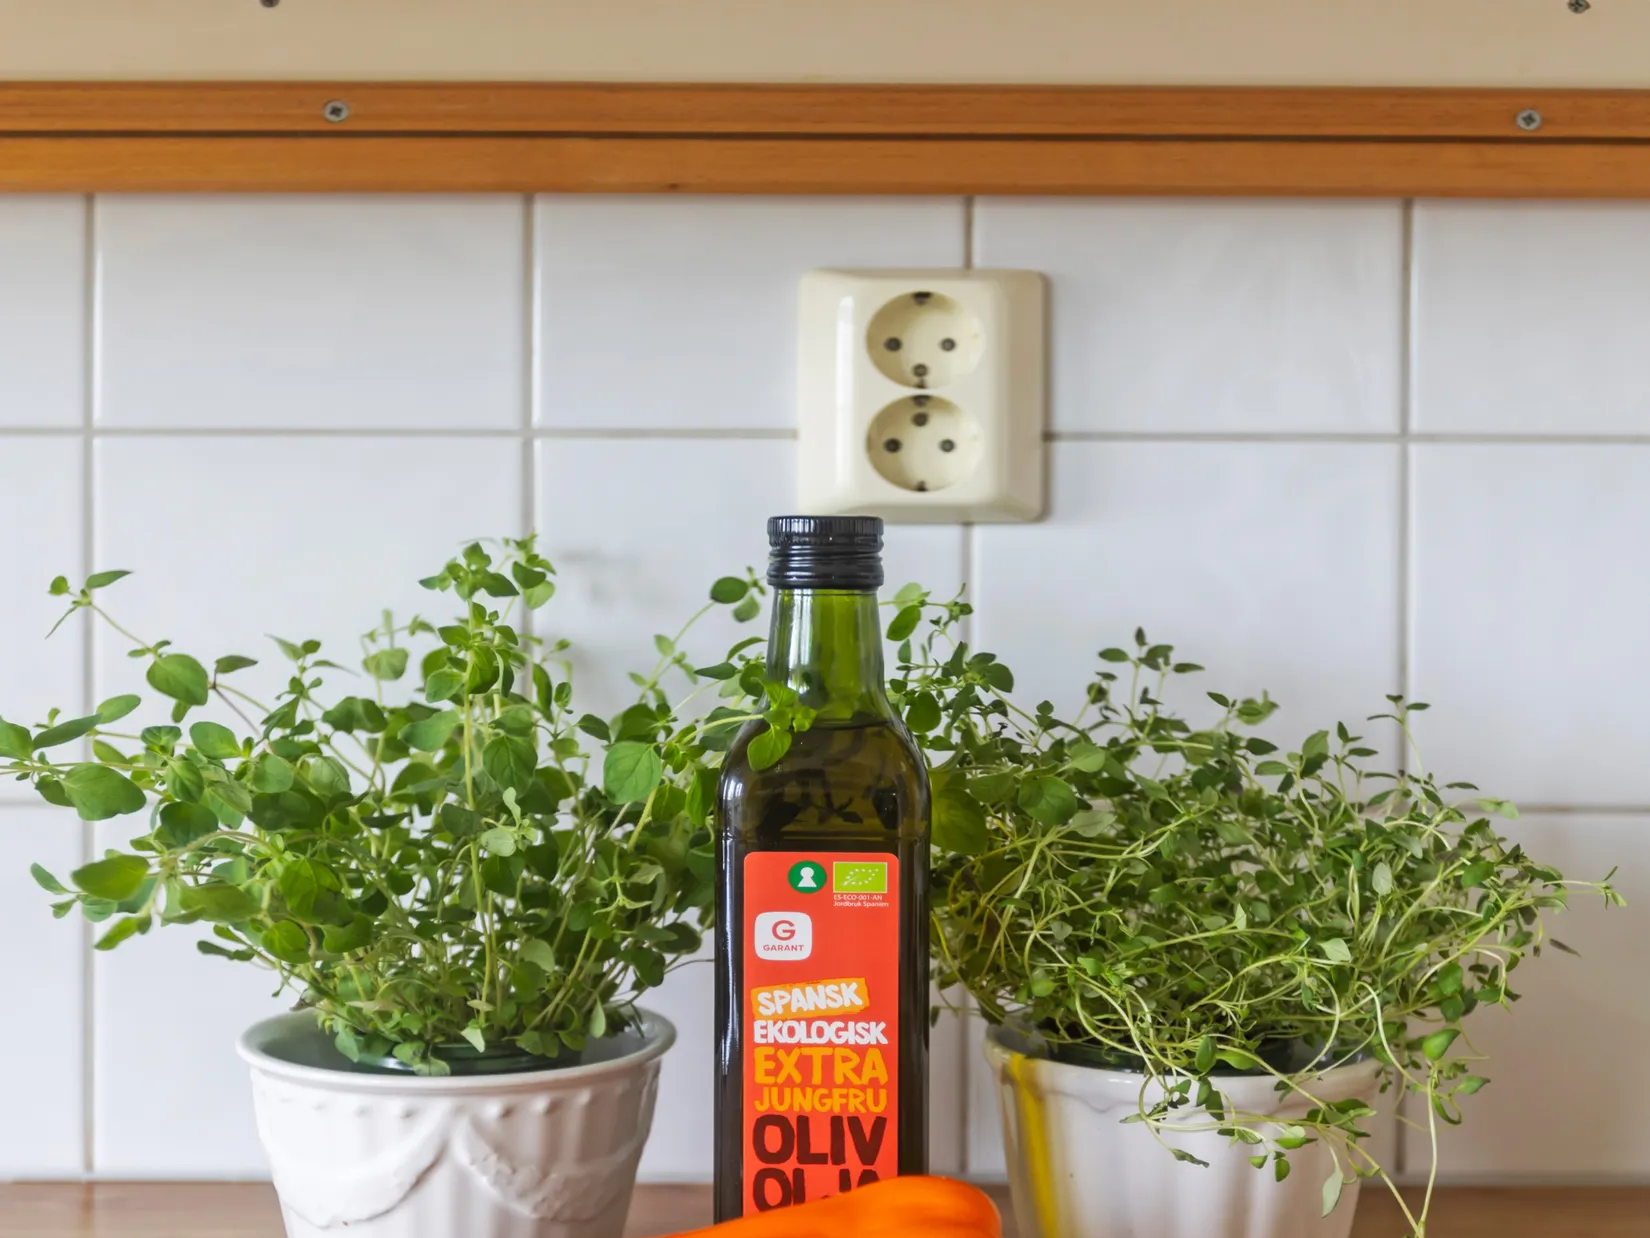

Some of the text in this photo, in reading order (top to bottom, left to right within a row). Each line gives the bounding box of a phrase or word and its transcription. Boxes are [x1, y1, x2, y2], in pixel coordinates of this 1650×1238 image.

[771, 919, 796, 941] G
[763, 944, 805, 952] GARANT
[757, 981, 864, 1016] SPANSK
[753, 1020, 889, 1045] EKOLOGISK
[753, 1046, 889, 1085] EXTRA
[753, 1086, 889, 1113] JUNGFRU
[752, 1114, 888, 1166] OLIV
